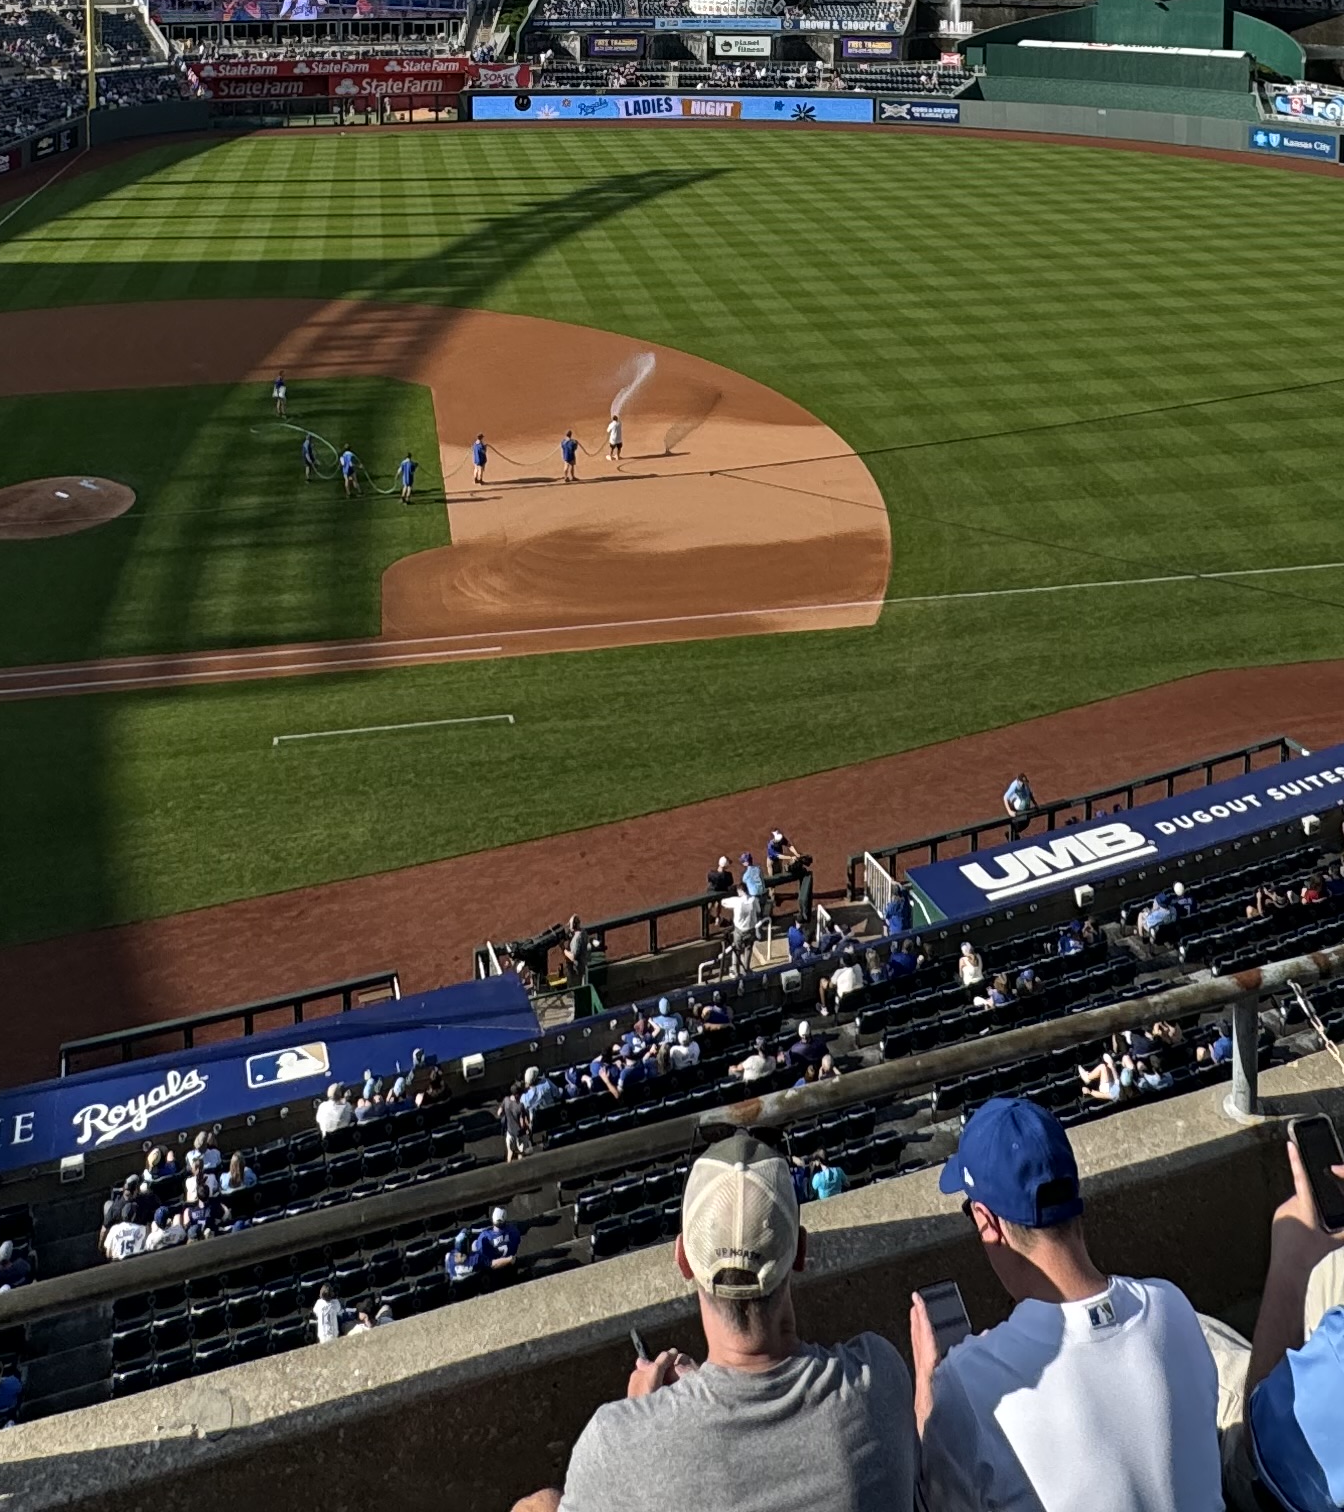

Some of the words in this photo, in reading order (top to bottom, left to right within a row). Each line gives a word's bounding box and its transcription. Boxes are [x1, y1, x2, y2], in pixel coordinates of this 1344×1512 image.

[799, 21, 831, 30] BROWN
[832, 21, 841, 30] &
[735, 39, 760, 47] planet
[578, 97, 608, 116] Royals
[625, 97, 674, 116] LADIES
[690, 100, 734, 117] NIGHT
[1283, 137, 1313, 149] Kansas
[1314, 141, 1331, 154] City
[959, 822, 1147, 890] UMB
[1155, 793, 1262, 835] DUGOUT
[73, 1068, 208, 1146] Royals
[120, 1238, 135, 1255] 15
